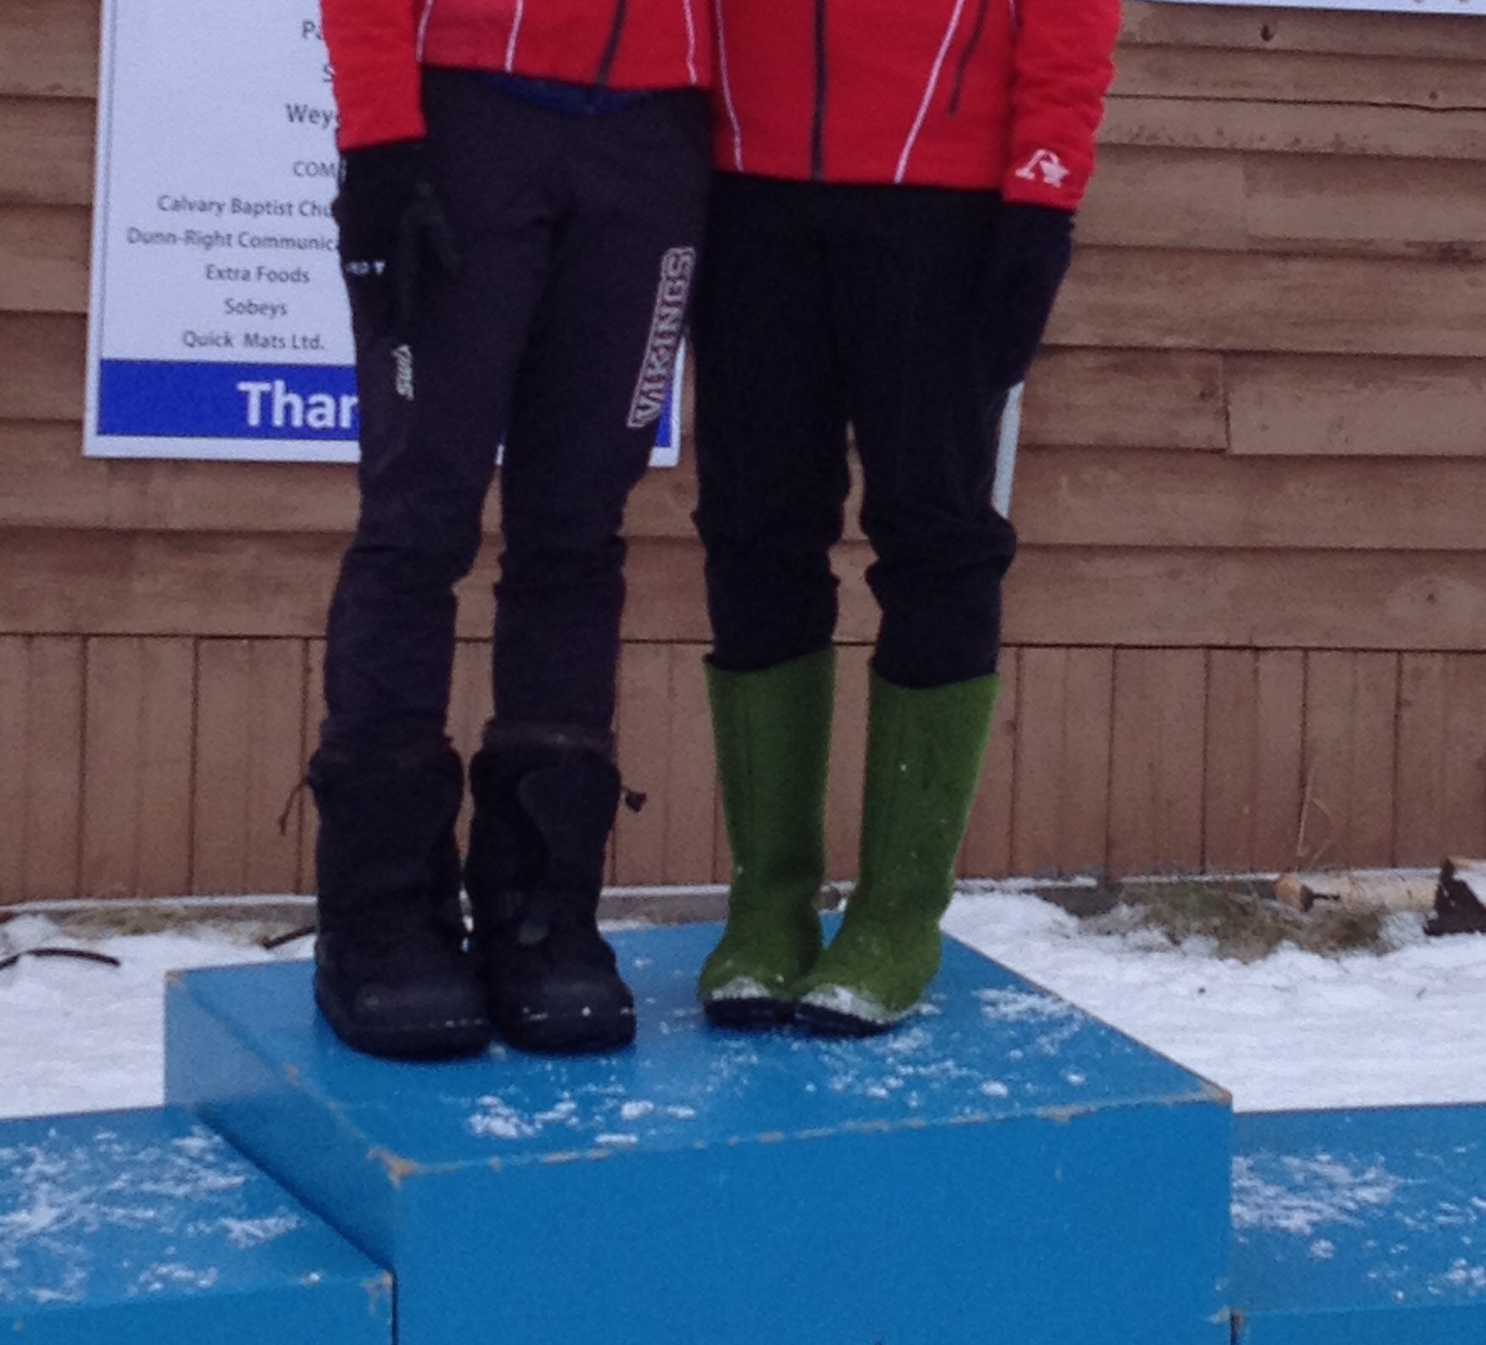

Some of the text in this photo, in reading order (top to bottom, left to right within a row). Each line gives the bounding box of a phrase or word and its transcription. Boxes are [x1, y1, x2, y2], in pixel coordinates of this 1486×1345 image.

[286, 103, 341, 129] Wey
[156, 195, 334, 218] Calvary Baptist Chu
[127, 226, 232, 250] Dunn-Right
[206, 265, 310, 284] Extra Foods
[224, 297, 288, 320] Sobeys
[182, 330, 325, 351] Quick Mats Ltd.
[630, 247, 695, 424] VIKINGS
